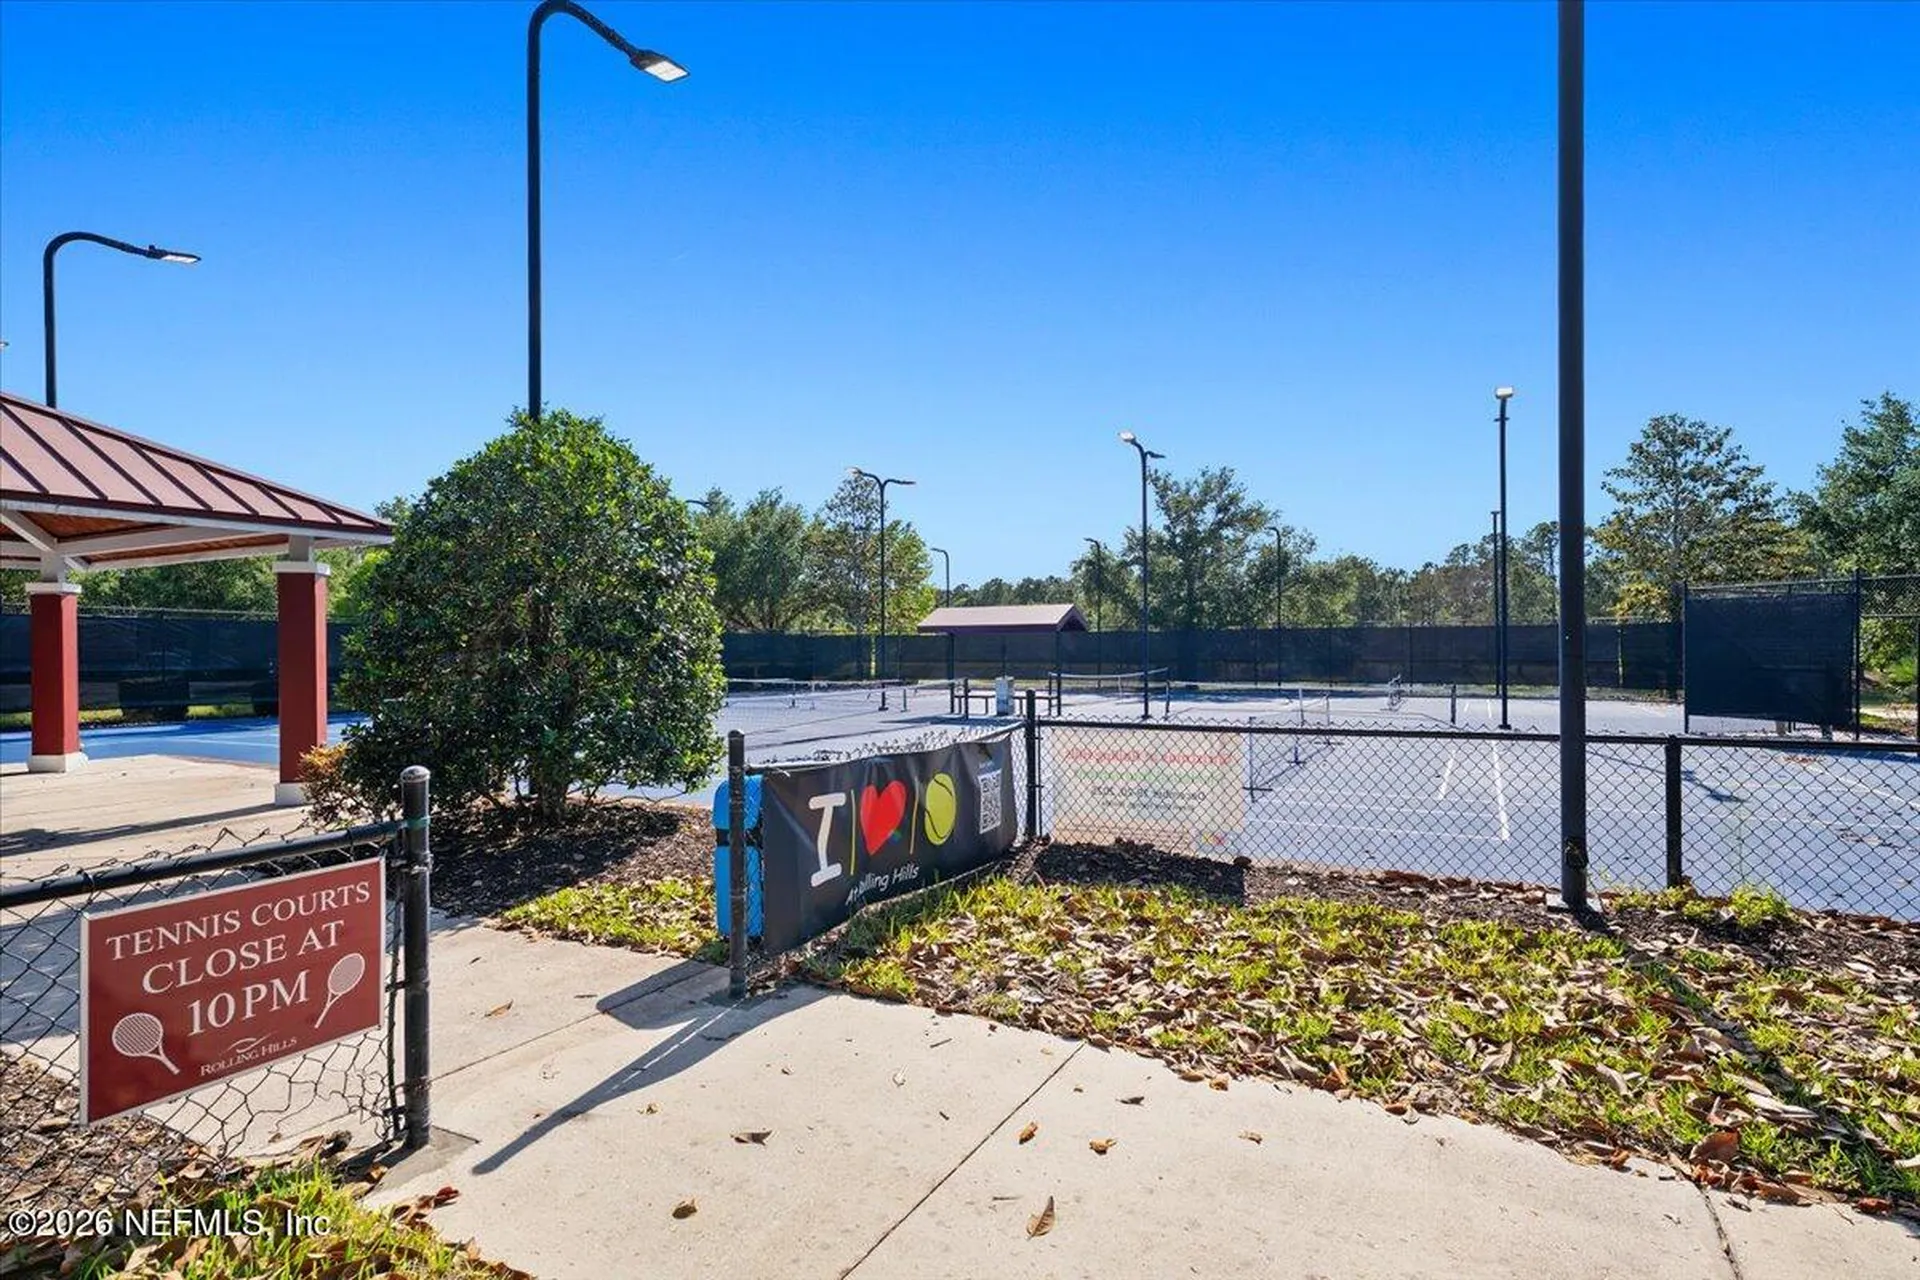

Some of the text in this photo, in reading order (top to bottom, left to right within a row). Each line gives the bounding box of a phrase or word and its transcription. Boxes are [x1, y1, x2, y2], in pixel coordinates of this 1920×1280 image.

[808, 792, 847, 888] I
[892, 863, 920, 885] Hills
[106, 881, 371, 961] TENNIS COURTS
[142, 920, 345, 994] CLOSE AT
[200, 1037, 298, 1077] ROLLING HILLS
